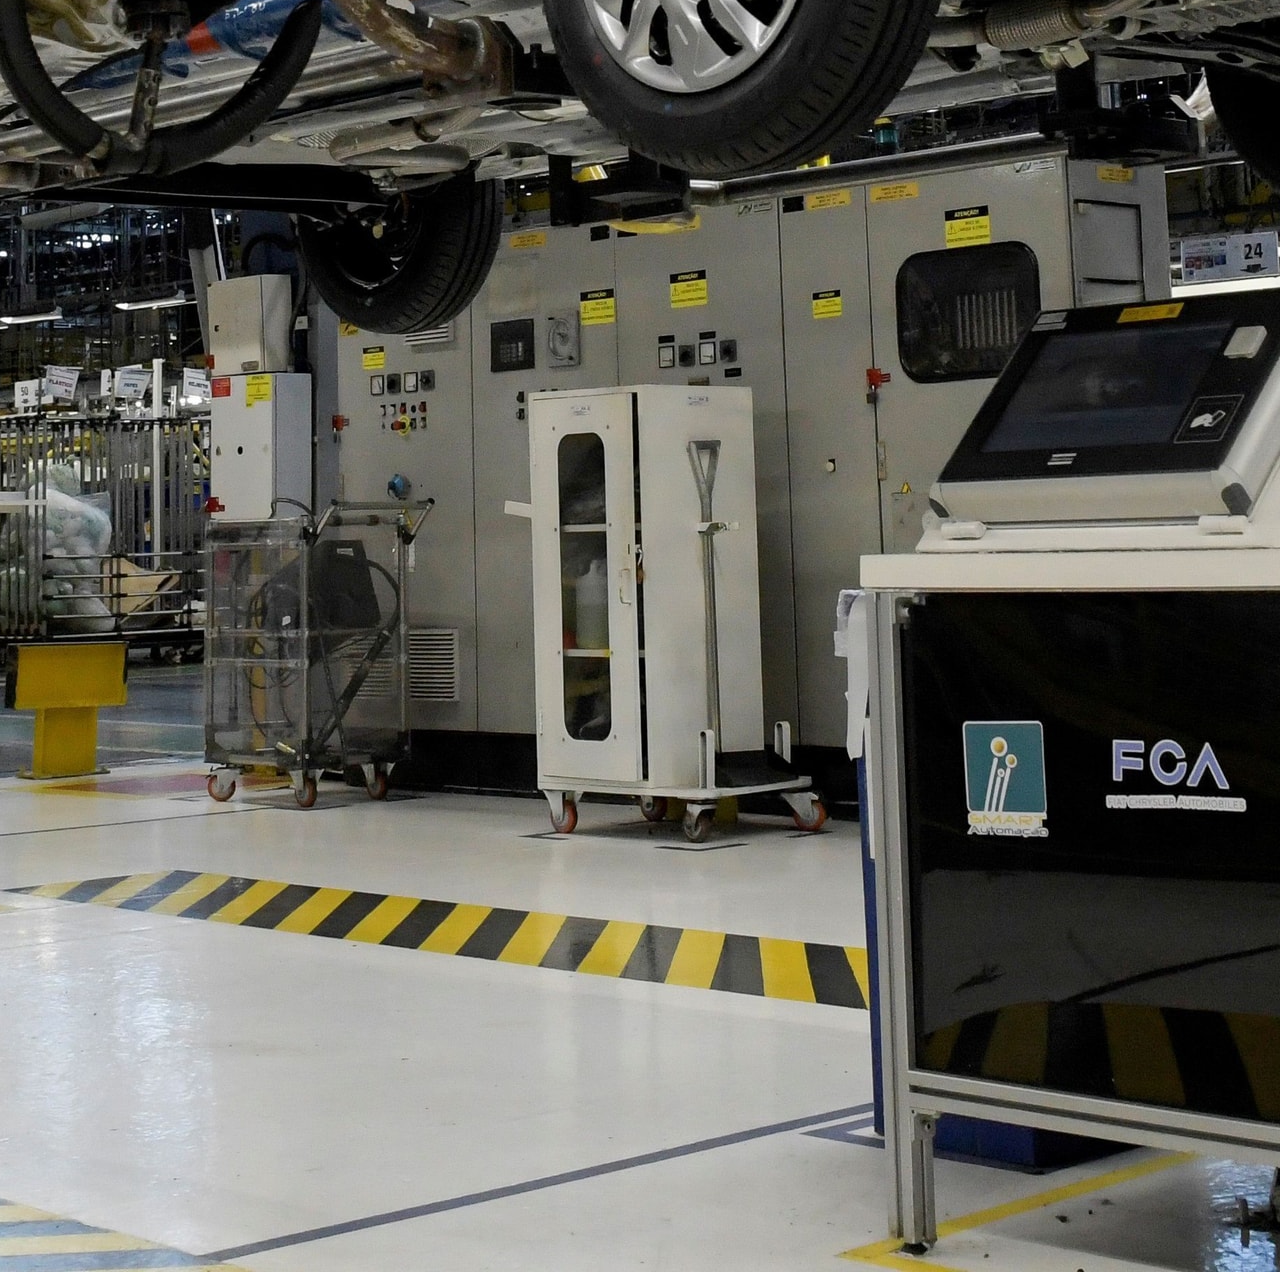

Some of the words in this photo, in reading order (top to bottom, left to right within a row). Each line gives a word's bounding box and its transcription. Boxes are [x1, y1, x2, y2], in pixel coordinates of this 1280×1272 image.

[1243, 243, 1264, 260] 24
[1112, 739, 1230, 790] FCA
[1107, 795, 1127, 808] FIAT
[1128, 795, 1176, 808] CHRYSLER
[1178, 796, 1246, 812] AUTOMOBILES
[969, 813, 1044, 826] SMART
[970, 825, 1049, 837] Automação
